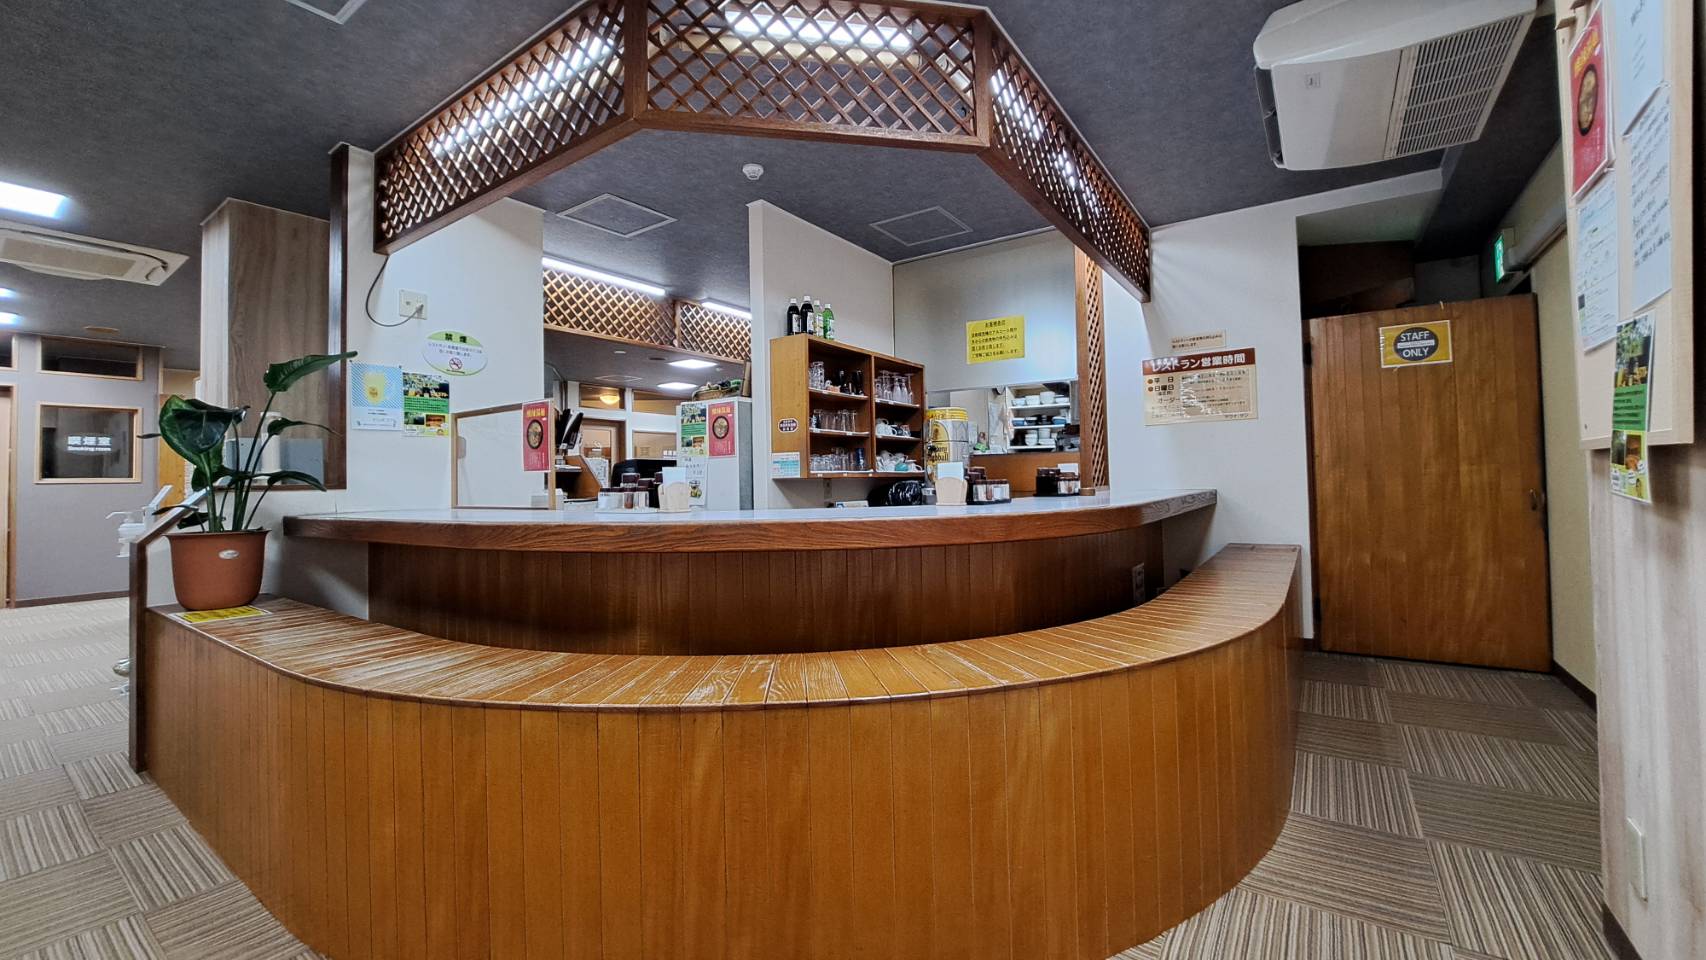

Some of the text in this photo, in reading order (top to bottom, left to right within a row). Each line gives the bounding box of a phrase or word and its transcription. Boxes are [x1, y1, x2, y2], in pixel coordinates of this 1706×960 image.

[1401, 331, 1429, 341] STAFF
[1403, 348, 1428, 357] ONLY
[1151, 353, 1246, 371] レストラン営業時間
